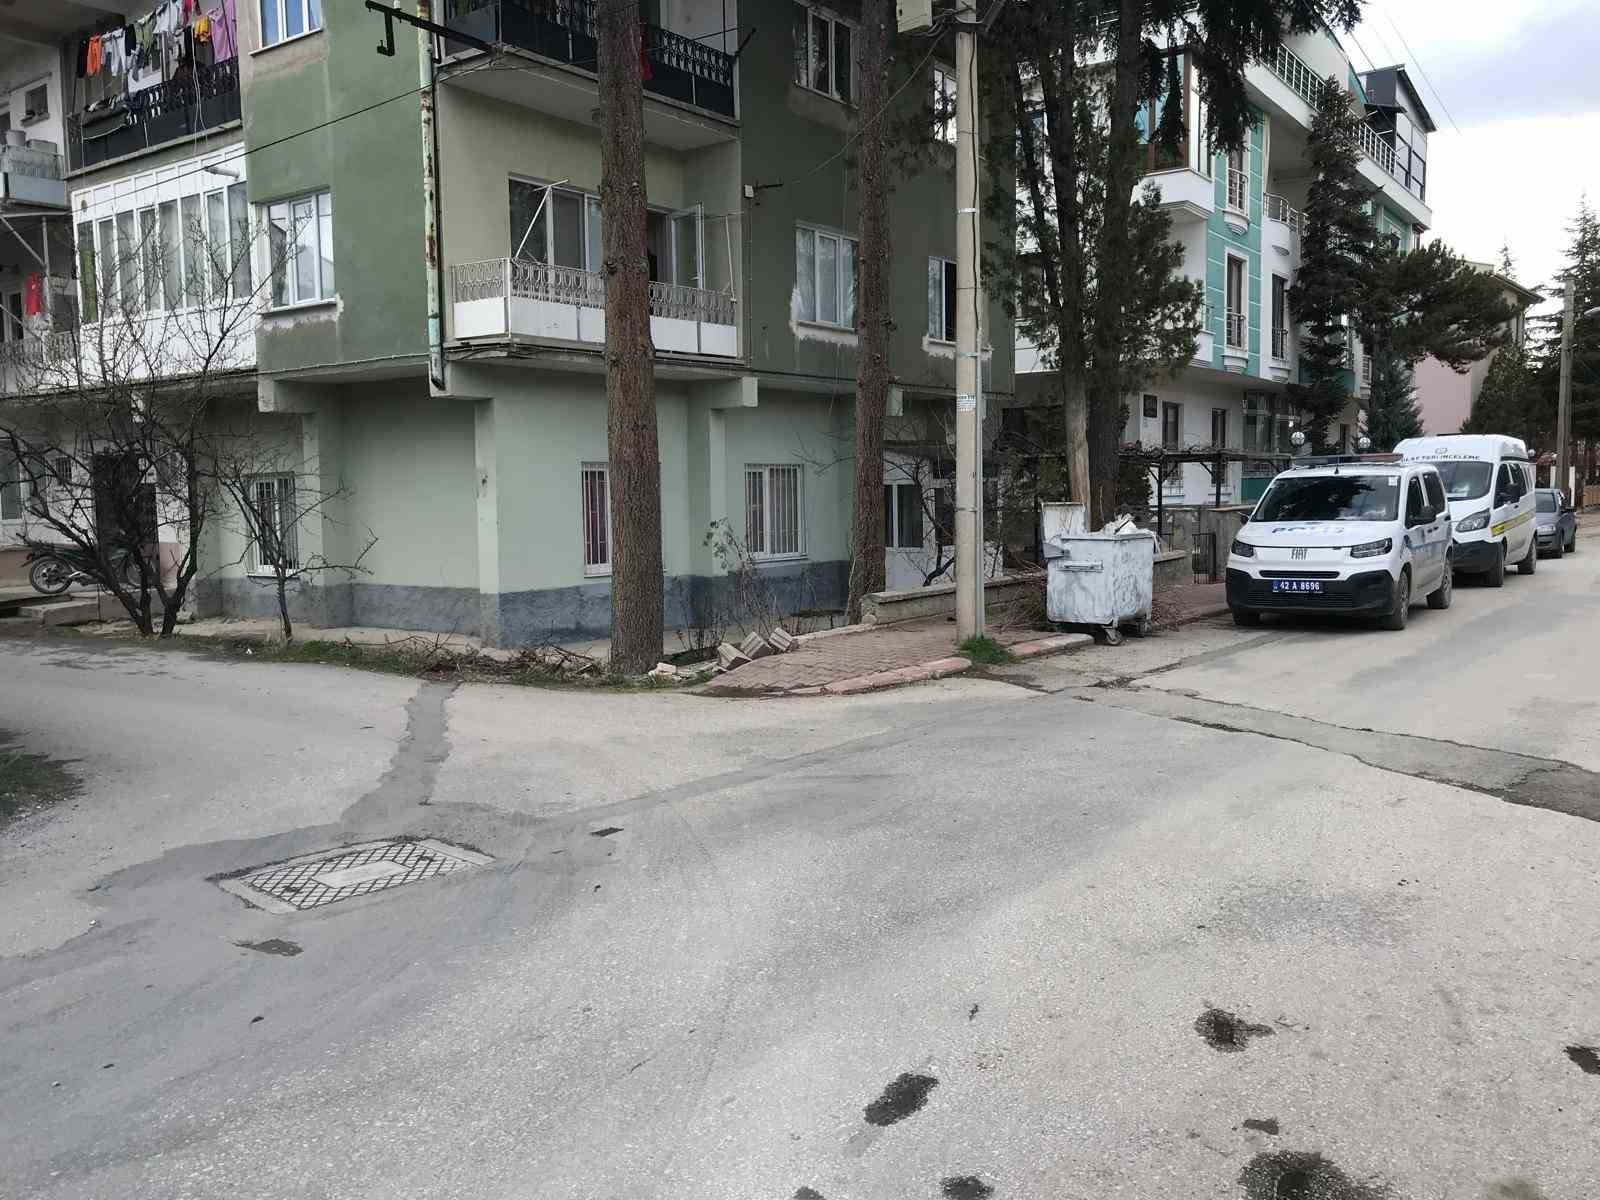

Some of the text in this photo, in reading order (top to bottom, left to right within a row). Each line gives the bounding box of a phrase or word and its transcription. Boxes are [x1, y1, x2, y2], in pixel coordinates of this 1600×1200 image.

[1291, 548, 1308, 560] FIAT
[1279, 581, 1290, 590] 42
[1292, 581, 1298, 590] A
